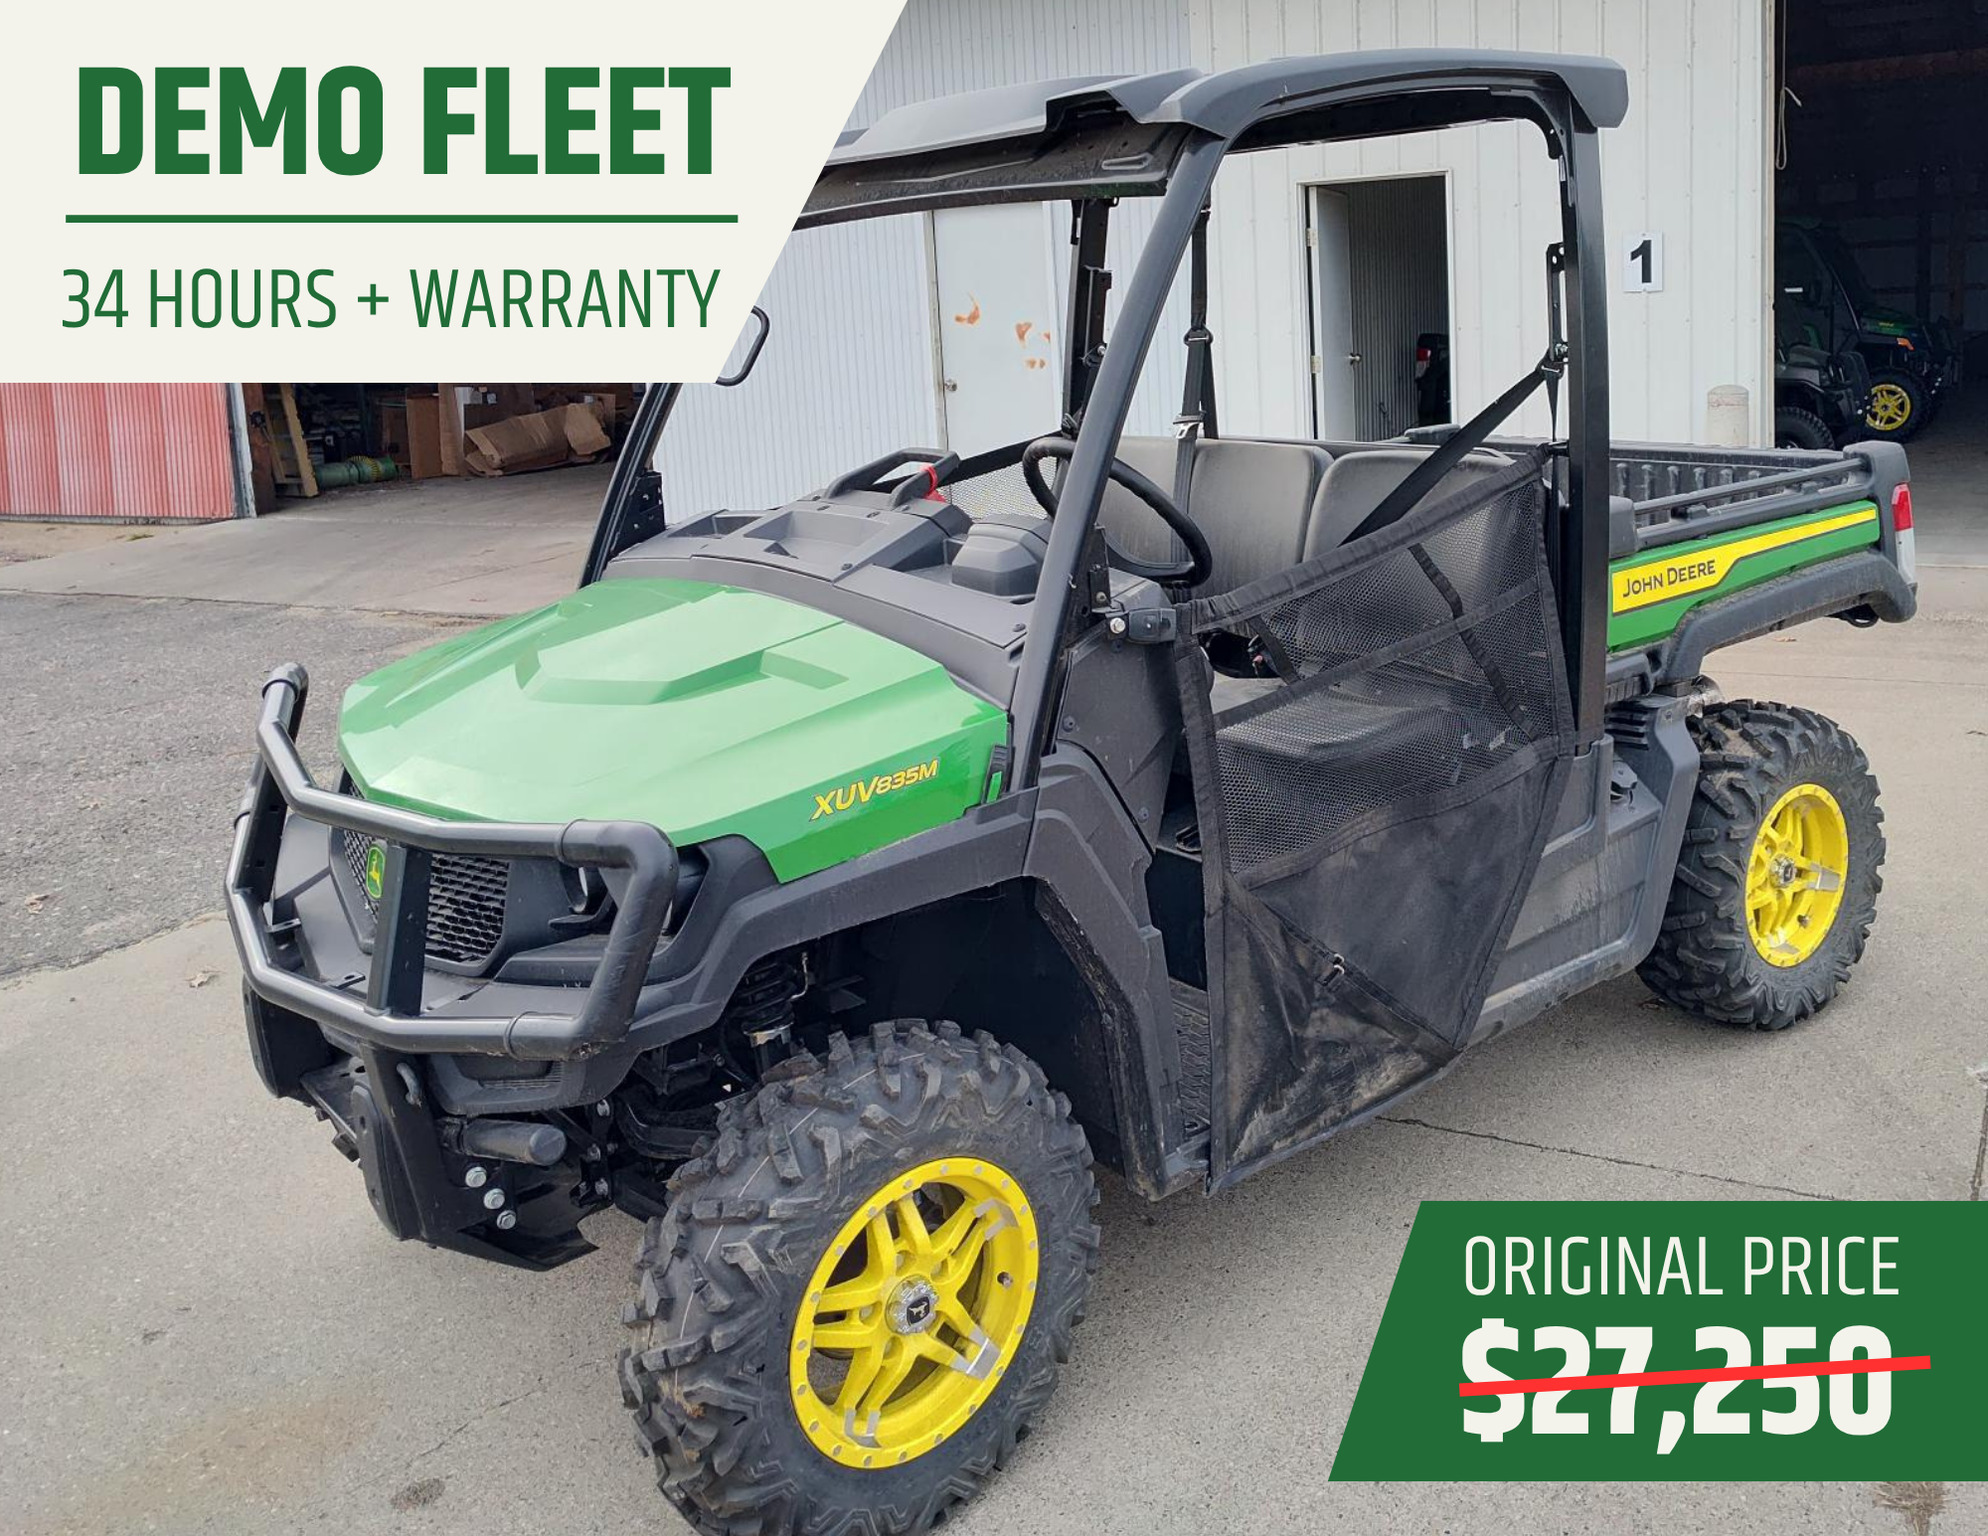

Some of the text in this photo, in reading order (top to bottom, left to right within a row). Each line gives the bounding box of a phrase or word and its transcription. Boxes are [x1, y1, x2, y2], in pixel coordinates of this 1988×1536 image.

[1630, 239, 1652, 283] 1
[1623, 559, 1716, 597] JOHN DEERE
[809, 758, 939, 821] XUV835M
